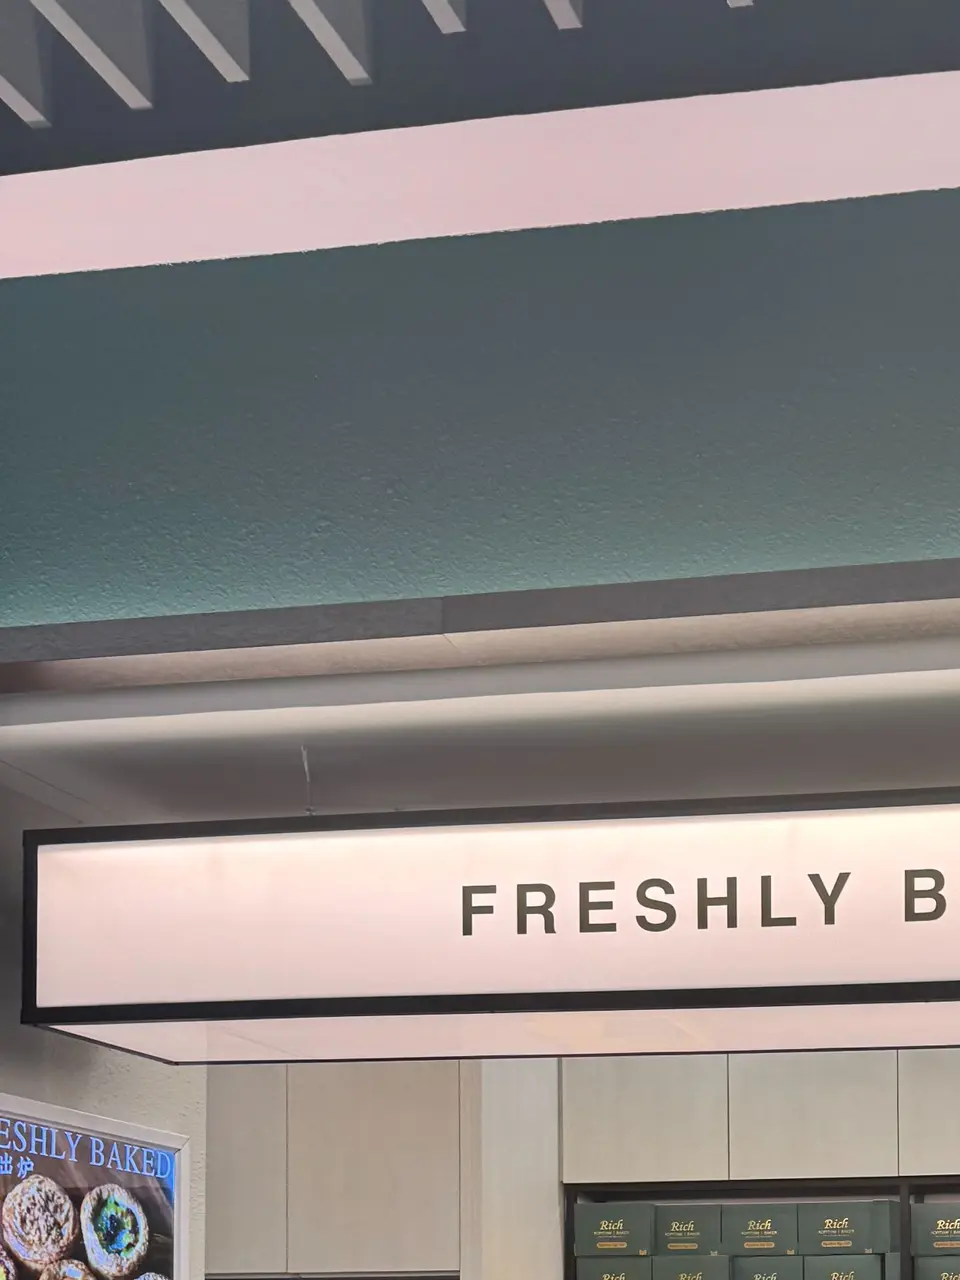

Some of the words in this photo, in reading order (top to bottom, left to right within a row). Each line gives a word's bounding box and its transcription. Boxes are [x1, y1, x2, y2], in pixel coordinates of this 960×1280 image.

[461, 872, 852, 936] FRESHLY
[90, 1136, 171, 1179] BAKED
[600, 1219, 624, 1230] Rich
[671, 1221, 695, 1232] Rich
[748, 1219, 772, 1230] Rich
[824, 1217, 849, 1229] Rich
[936, 1218, 960, 1230] Rich
